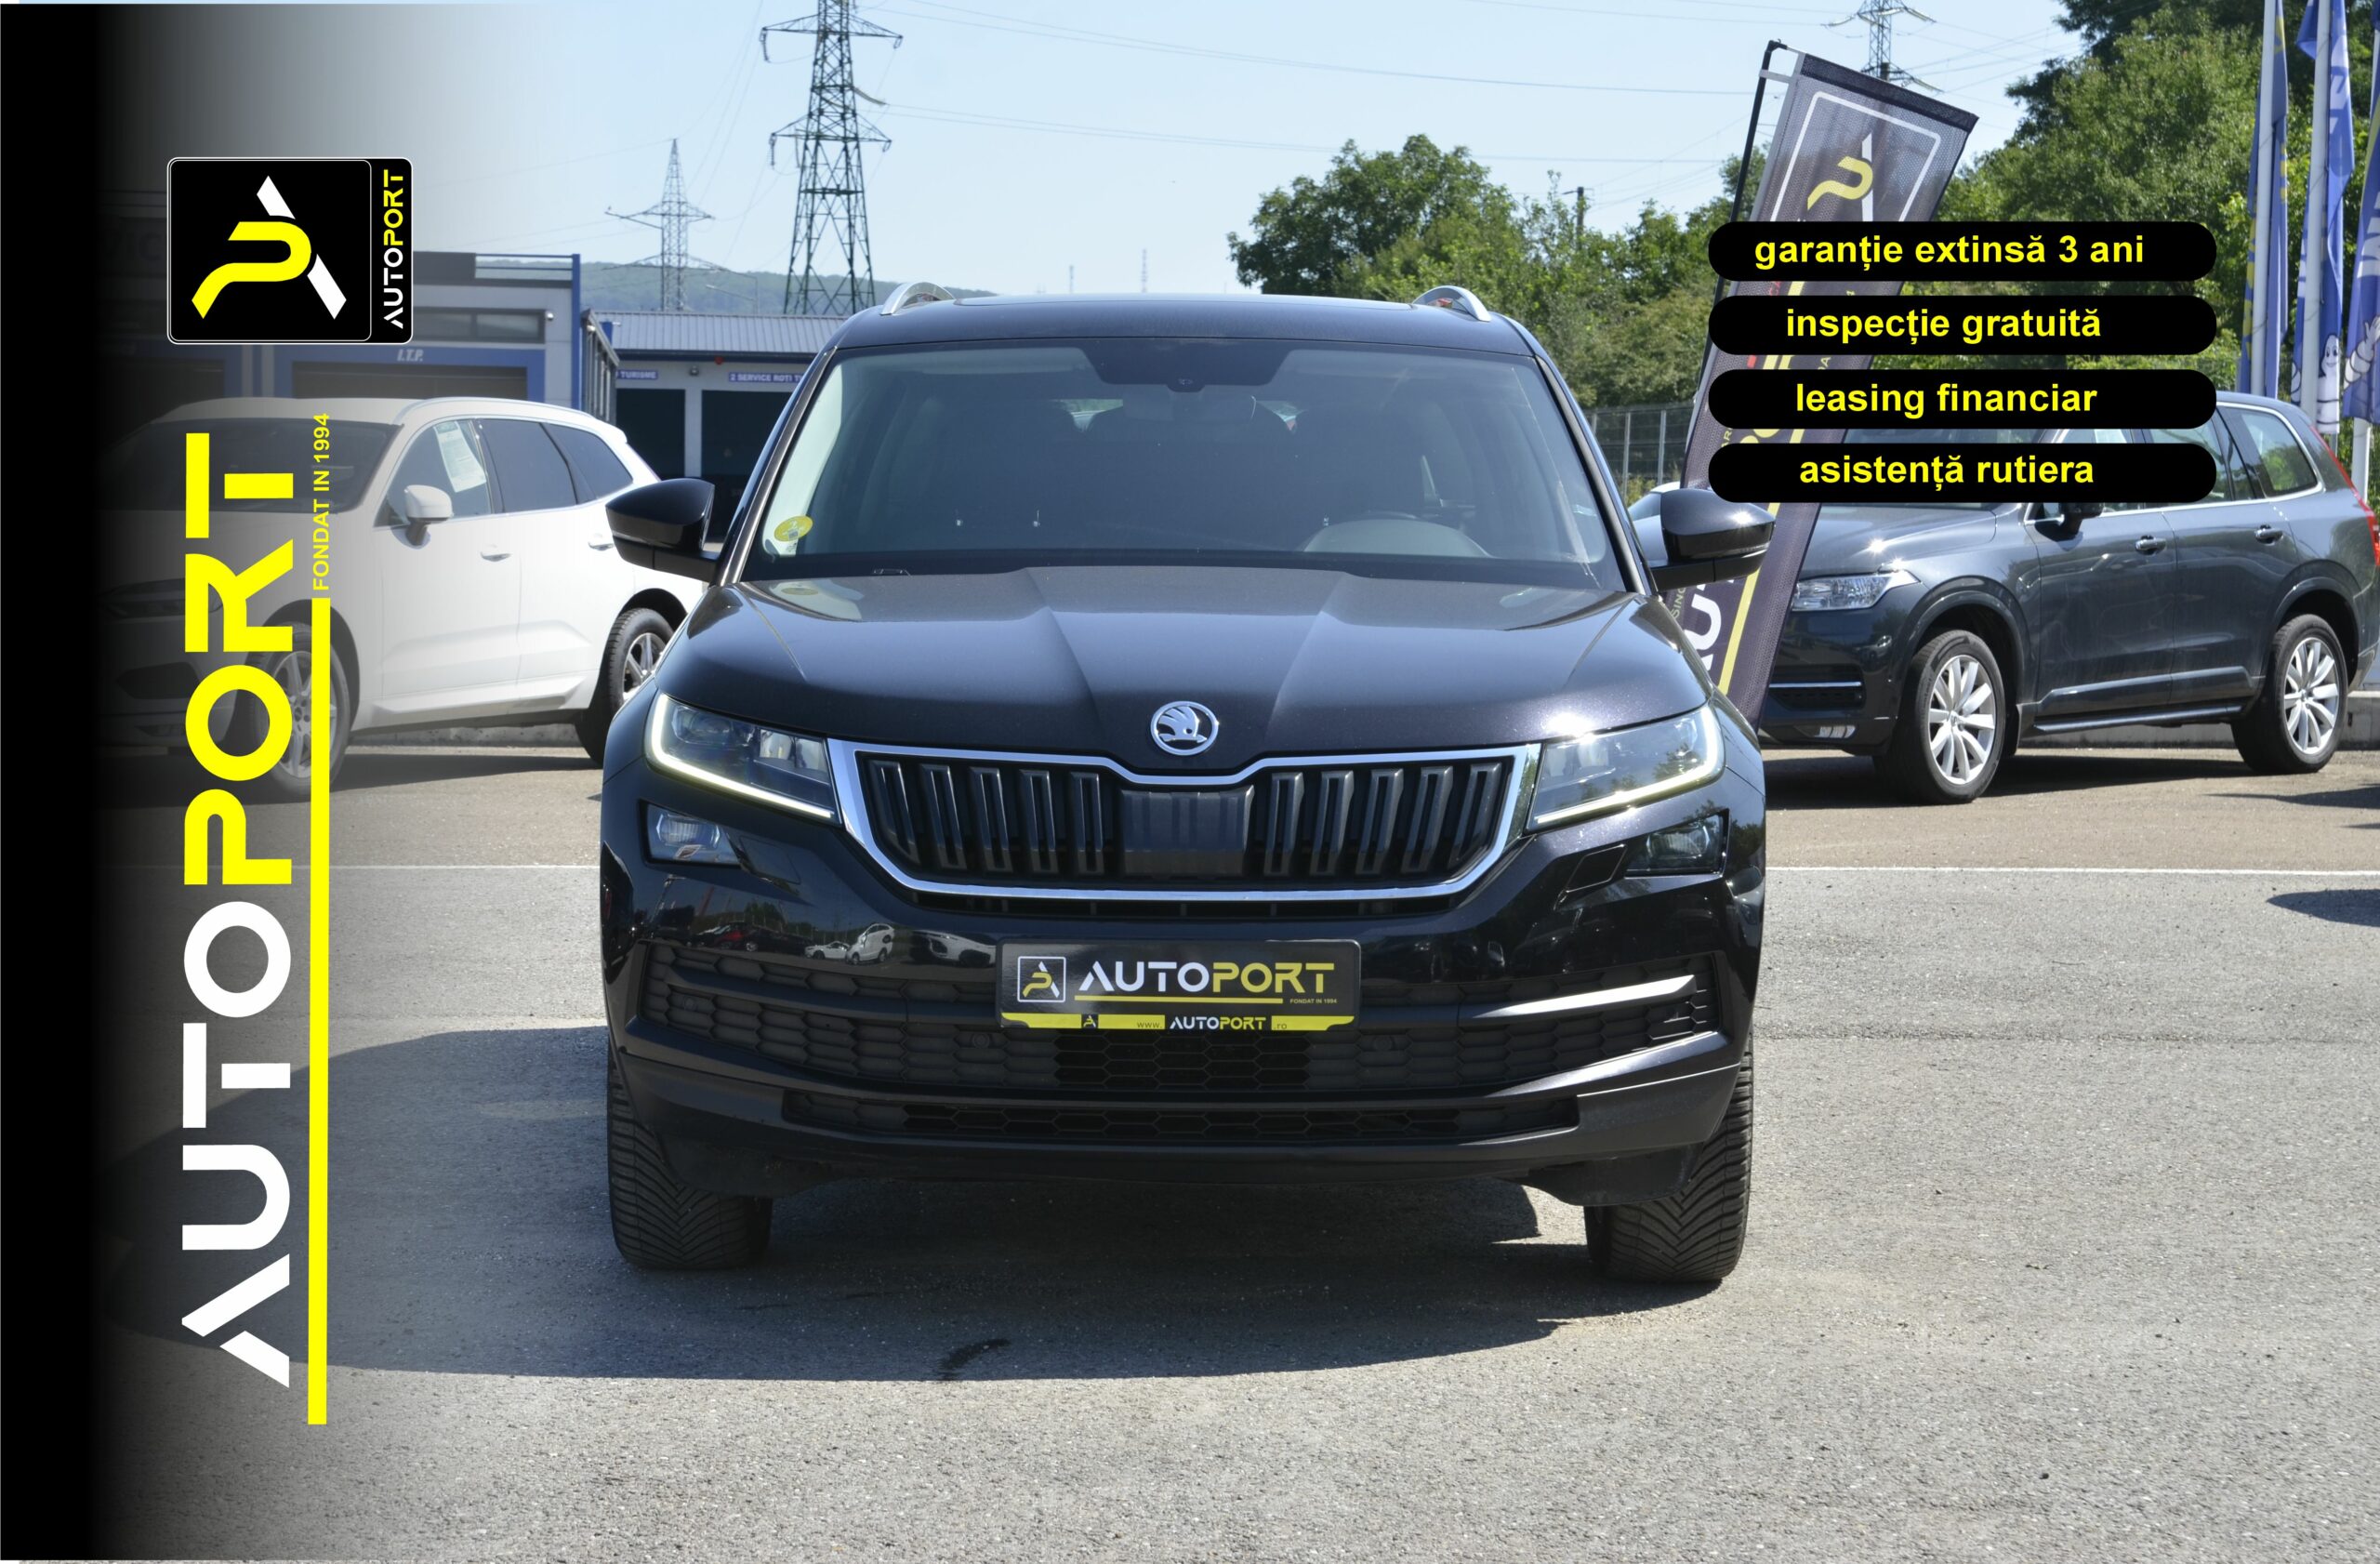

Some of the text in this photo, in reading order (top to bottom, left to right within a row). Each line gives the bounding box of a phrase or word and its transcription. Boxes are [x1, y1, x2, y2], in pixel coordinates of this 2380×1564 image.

[737, 374, 772, 382] SERVICE
[1078, 961, 1334, 994] AUTOPORT
[1170, 1016, 1266, 1030] AUTOPORT
